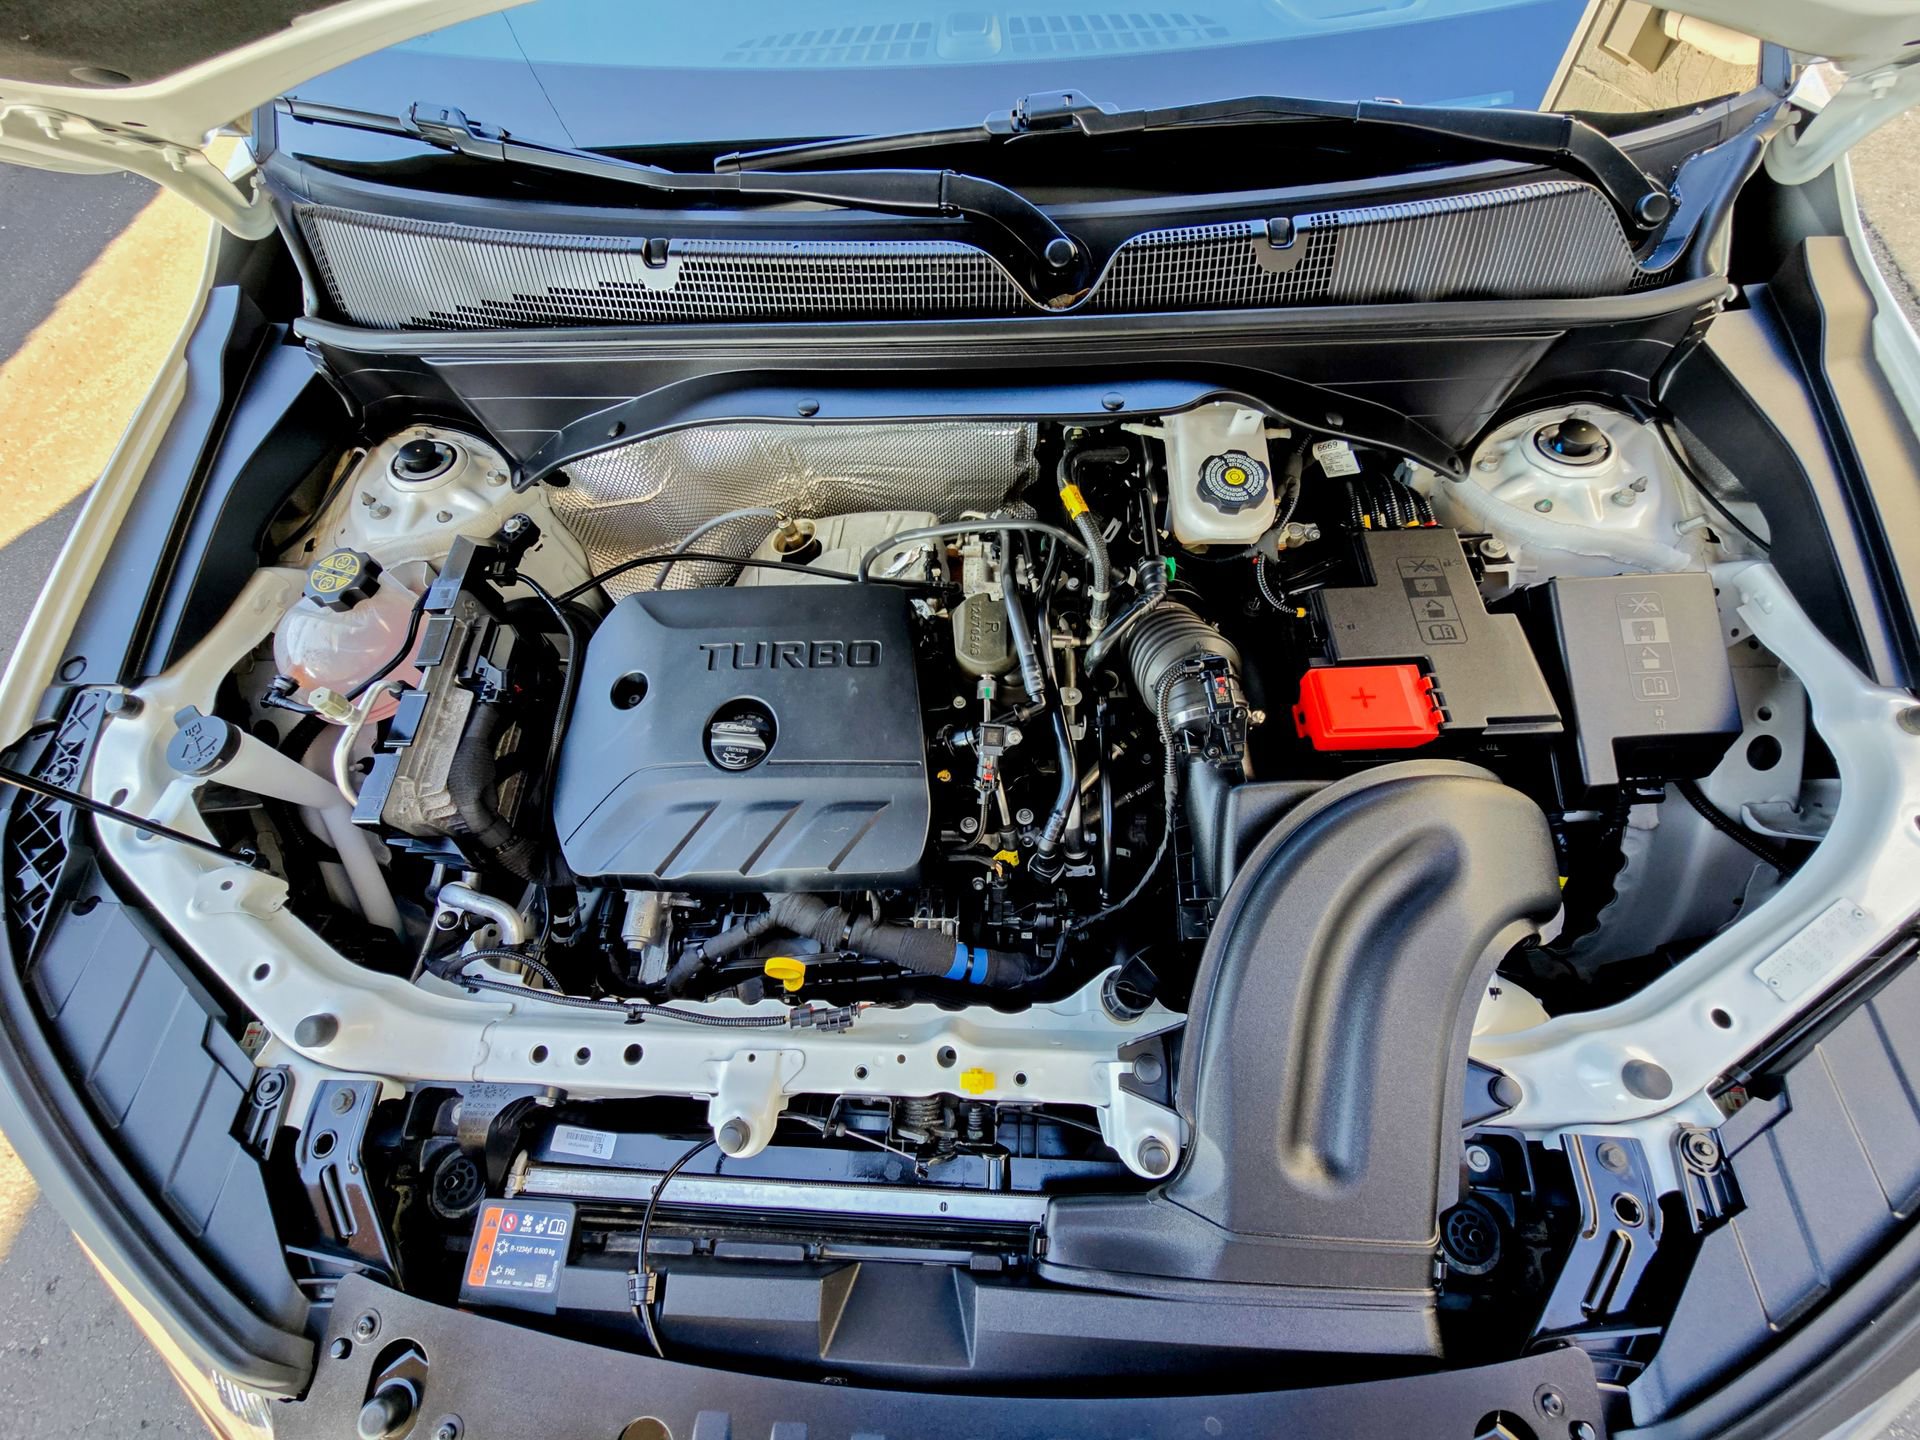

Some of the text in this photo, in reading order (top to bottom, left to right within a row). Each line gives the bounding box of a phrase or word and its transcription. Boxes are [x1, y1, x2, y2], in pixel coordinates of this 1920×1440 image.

[1317, 440, 1338, 452] 6669
[985, 621, 1000, 633] R
[700, 640, 882, 671] TURBO
[510, 1245, 533, 1254] R-1234yf
[548, 1248, 556, 1257] kg
[504, 1268, 516, 1276] PAG
